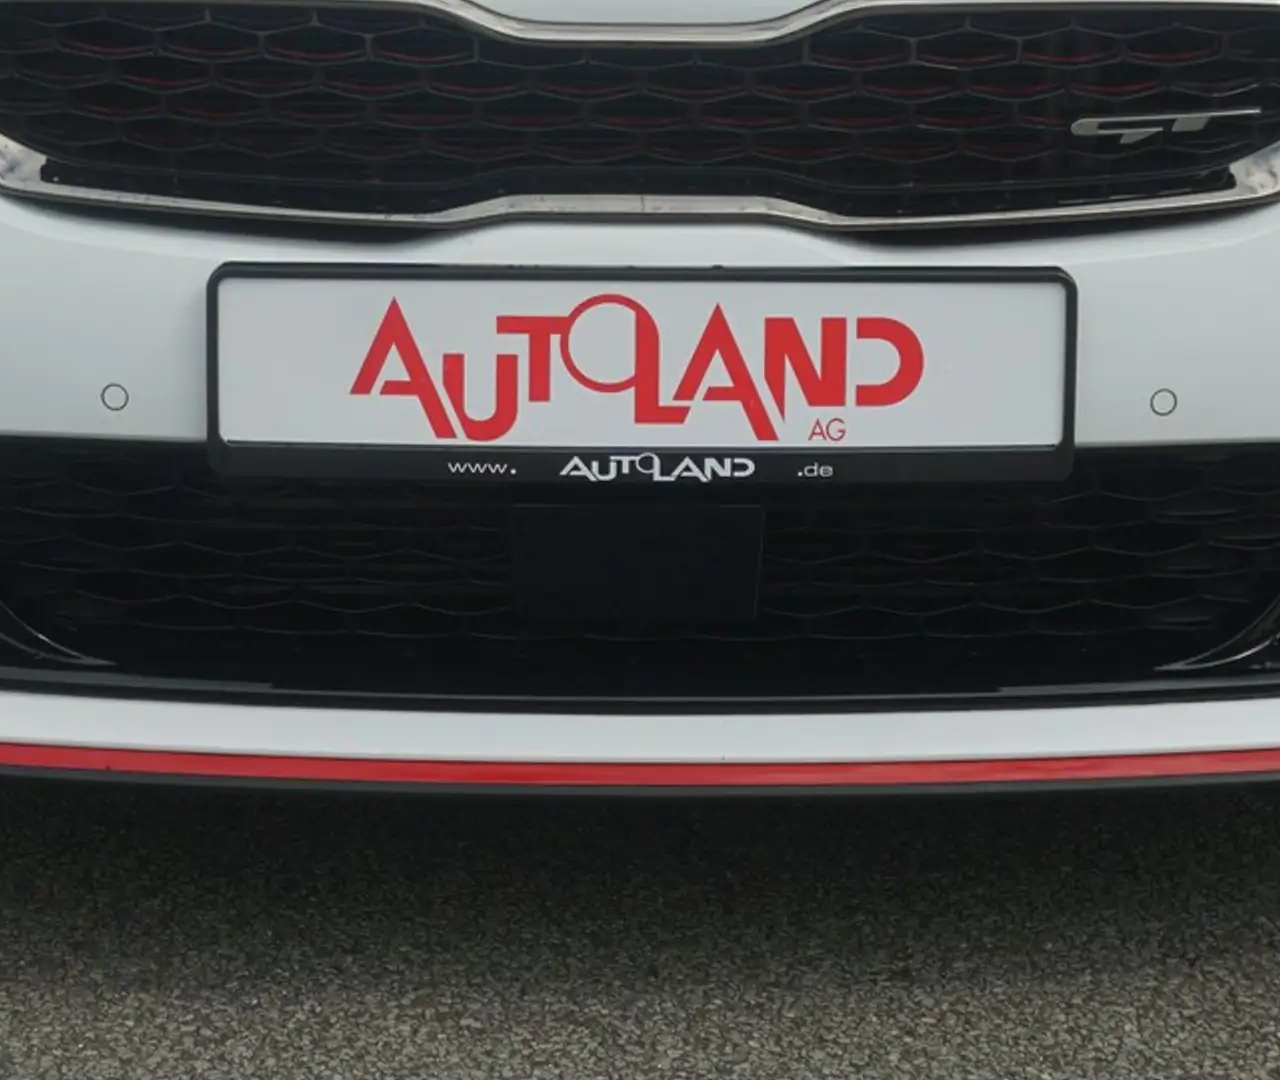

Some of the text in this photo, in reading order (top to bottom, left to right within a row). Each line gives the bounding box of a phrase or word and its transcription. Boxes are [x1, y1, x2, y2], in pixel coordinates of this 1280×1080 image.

[1070, 108, 1261, 144] GT
[349, 293, 924, 442] AUTOLAND
[807, 418, 847, 442] AG
[559, 452, 756, 482] AUTOLAND
